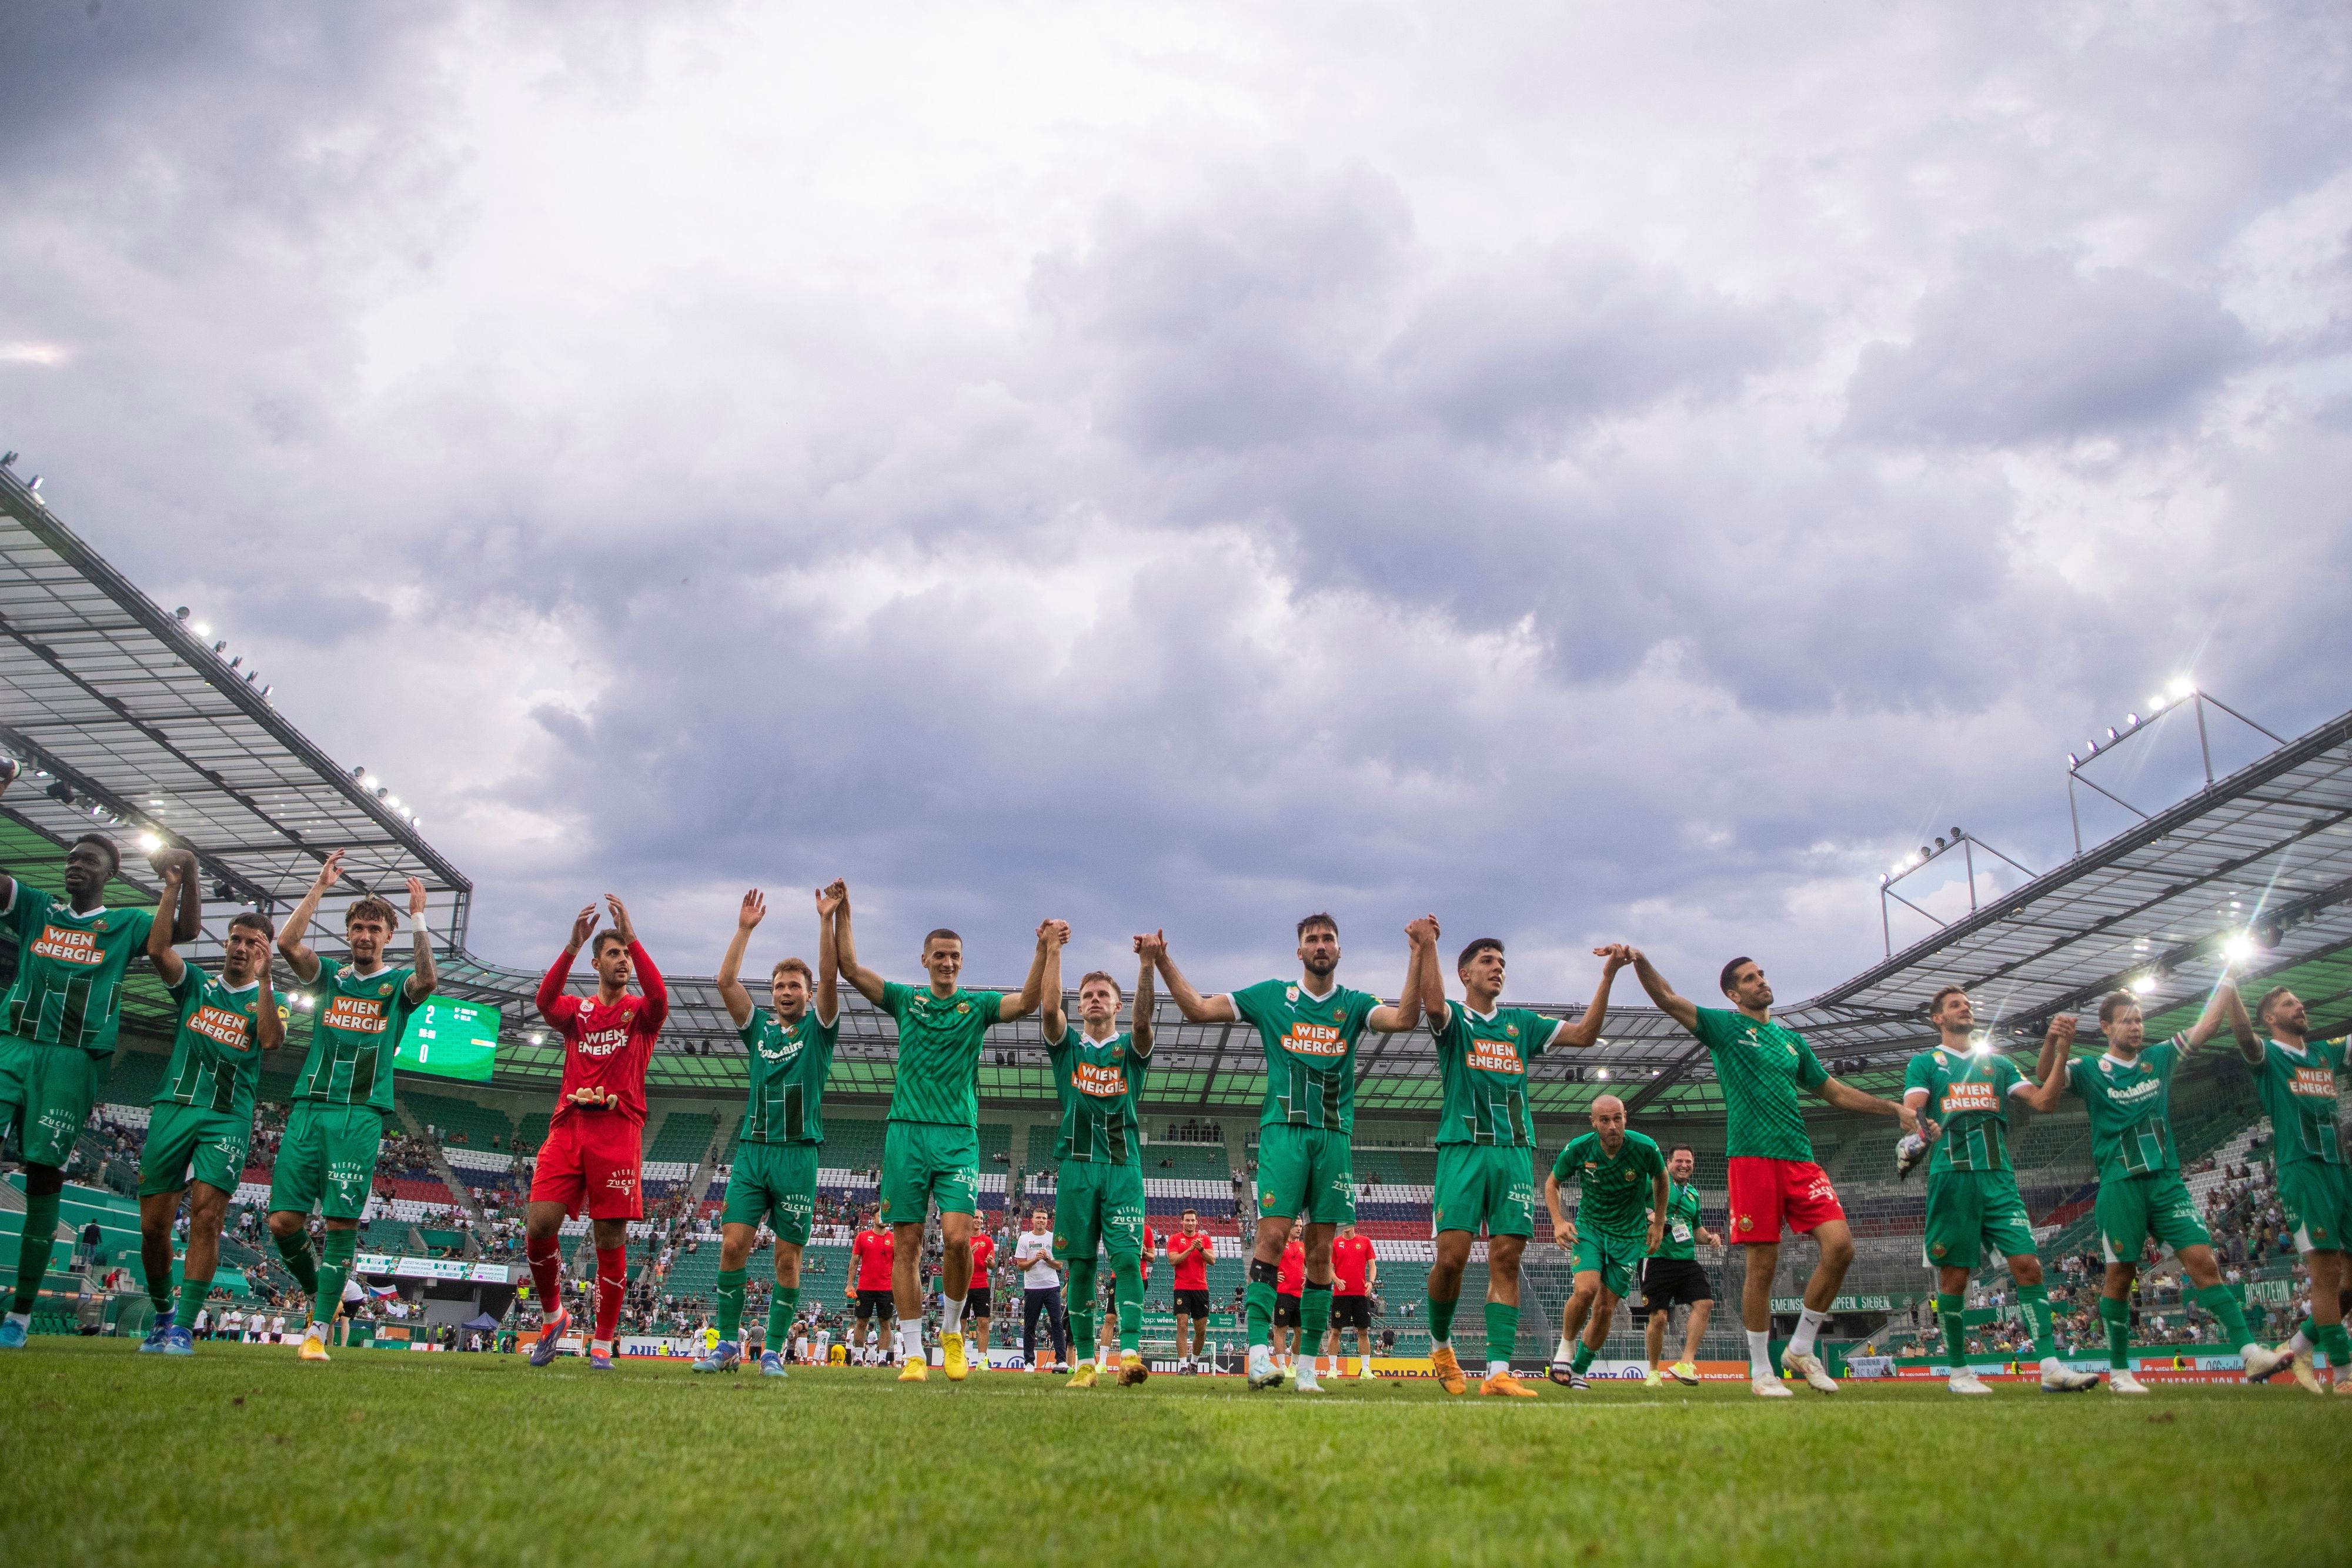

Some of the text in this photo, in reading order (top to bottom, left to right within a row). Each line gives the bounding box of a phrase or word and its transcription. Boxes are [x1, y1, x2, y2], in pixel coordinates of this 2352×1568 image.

[49, 928, 94, 947] WIEN
[34, 941, 102, 962] ENERGIE
[337, 999, 380, 1017] WIEN
[425, 1005, 435, 1024] 2
[203, 1008, 246, 1031] WIEN
[324, 1011, 387, 1031] ENERGIE
[189, 1015, 250, 1048] ENERGIE
[585, 1028, 624, 1044] WIEN
[1295, 1025, 1336, 1040] WIEN
[419, 1044, 429, 1064] 0
[1284, 1038, 1345, 1054] ENERGIE
[1476, 1042, 1514, 1057] WIEN
[1468, 1054, 1522, 1072] ENERGIE
[1082, 1065, 1118, 1081] WIEN
[2297, 1069, 2331, 1082] WIEN
[1951, 1084, 1991, 1095] WIEN
[1943, 1096, 1997, 1111] ENERGIE
[332, 1162, 361, 1172] WIENER
[328, 1171, 364, 1182] ZUCKER
[780, 1202, 811, 1213] ZUCKER
[2244, 1280, 2290, 1305] ACHTZEHN
[1770, 1296, 1892, 1312] EMEINSA MPFEN. SIEGEN.
[1996, 1306, 2003, 1323] SK
[822, 1338, 827, 1346] 4
[629, 1345, 689, 1357] Allinz
[1357, 1368, 1438, 1376] DMIRAL
